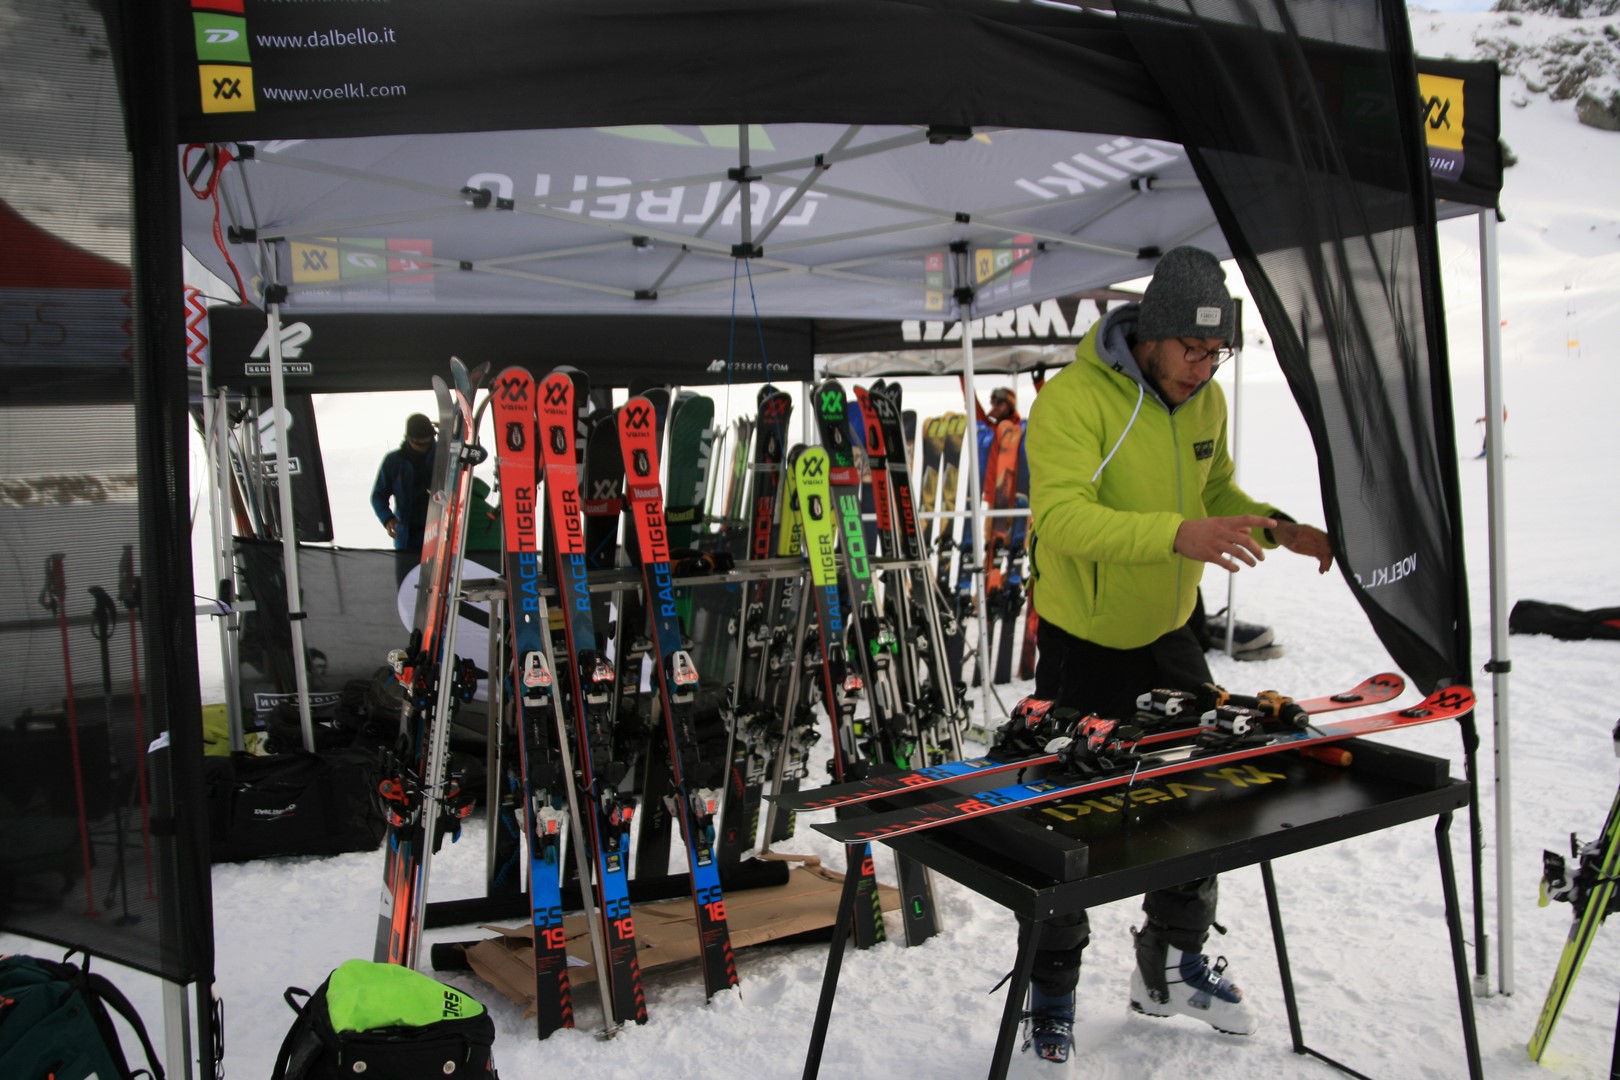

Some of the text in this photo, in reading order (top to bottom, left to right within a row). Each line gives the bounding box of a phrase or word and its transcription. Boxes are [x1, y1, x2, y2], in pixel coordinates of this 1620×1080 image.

[256, 26, 396, 48] www.dalbello.it
[262, 83, 407, 101] www.voelkl.com
[839, 494, 871, 580] CODE
[704, 900, 727, 922] 18
[541, 927, 567, 950] 19
[613, 917, 635, 940] 19
